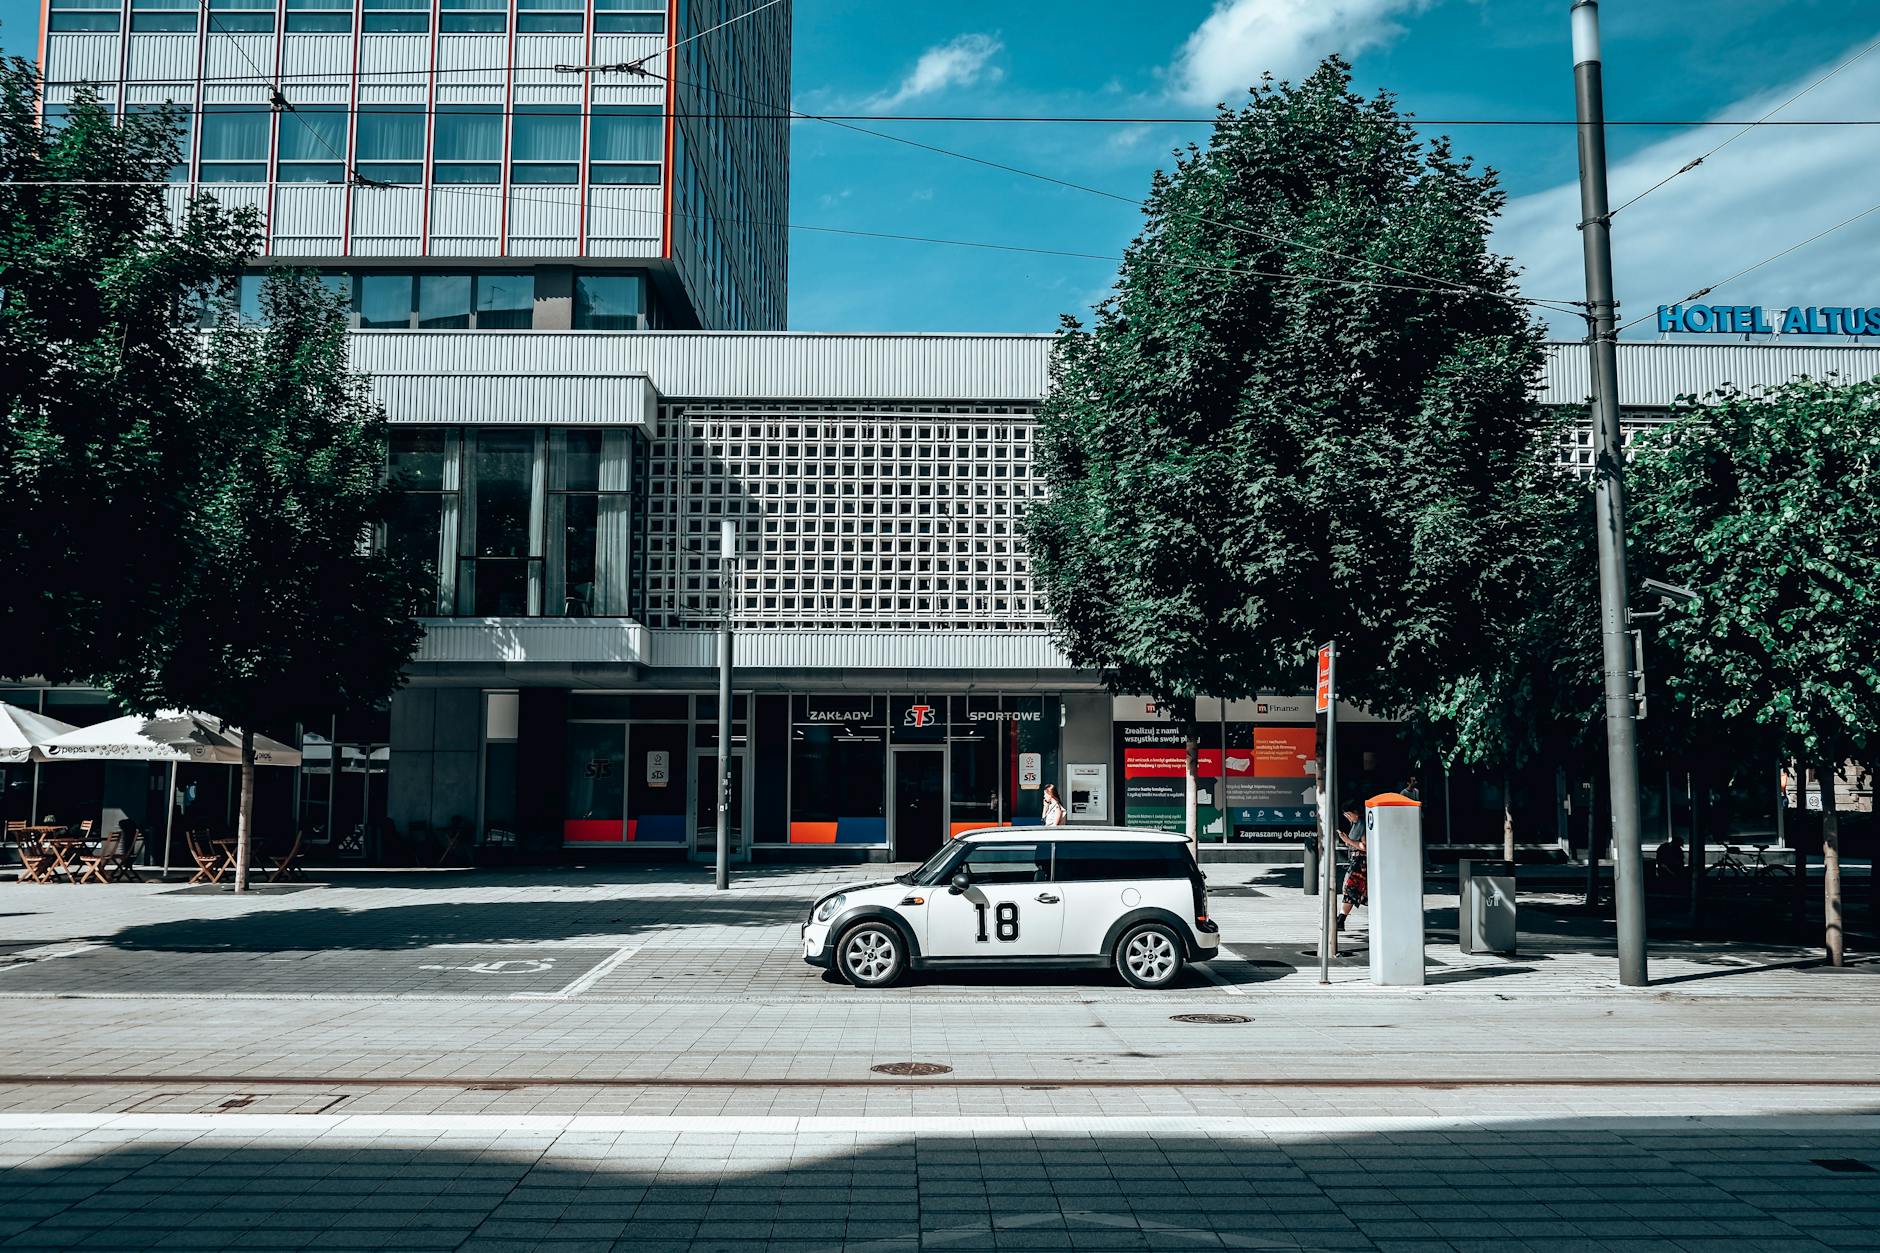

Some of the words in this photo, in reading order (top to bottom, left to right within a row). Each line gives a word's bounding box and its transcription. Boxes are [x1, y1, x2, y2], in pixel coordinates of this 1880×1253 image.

[1657, 304, 1773, 334] HOTEL
[1779, 306, 1880, 336] ALTUS
[1269, 704, 1299, 712] Finanse
[809, 711, 870, 721] ZAKŁADY
[903, 705, 936, 728] STS
[969, 711, 1041, 721] SPORTOWE
[1124, 727, 1155, 736] Zrealizuj
[1161, 727, 1179, 735] nami
[1124, 735, 1159, 744] wszystkie
[1160, 736, 1180, 744] swoje
[61, 745, 87, 755] pepsi
[651, 770, 665, 780] STS
[1024, 772, 1037, 782] STS
[1240, 830, 1283, 839] Zapraszamy
[1283, 829, 1293, 838] do
[973, 901, 1021, 943] 18
